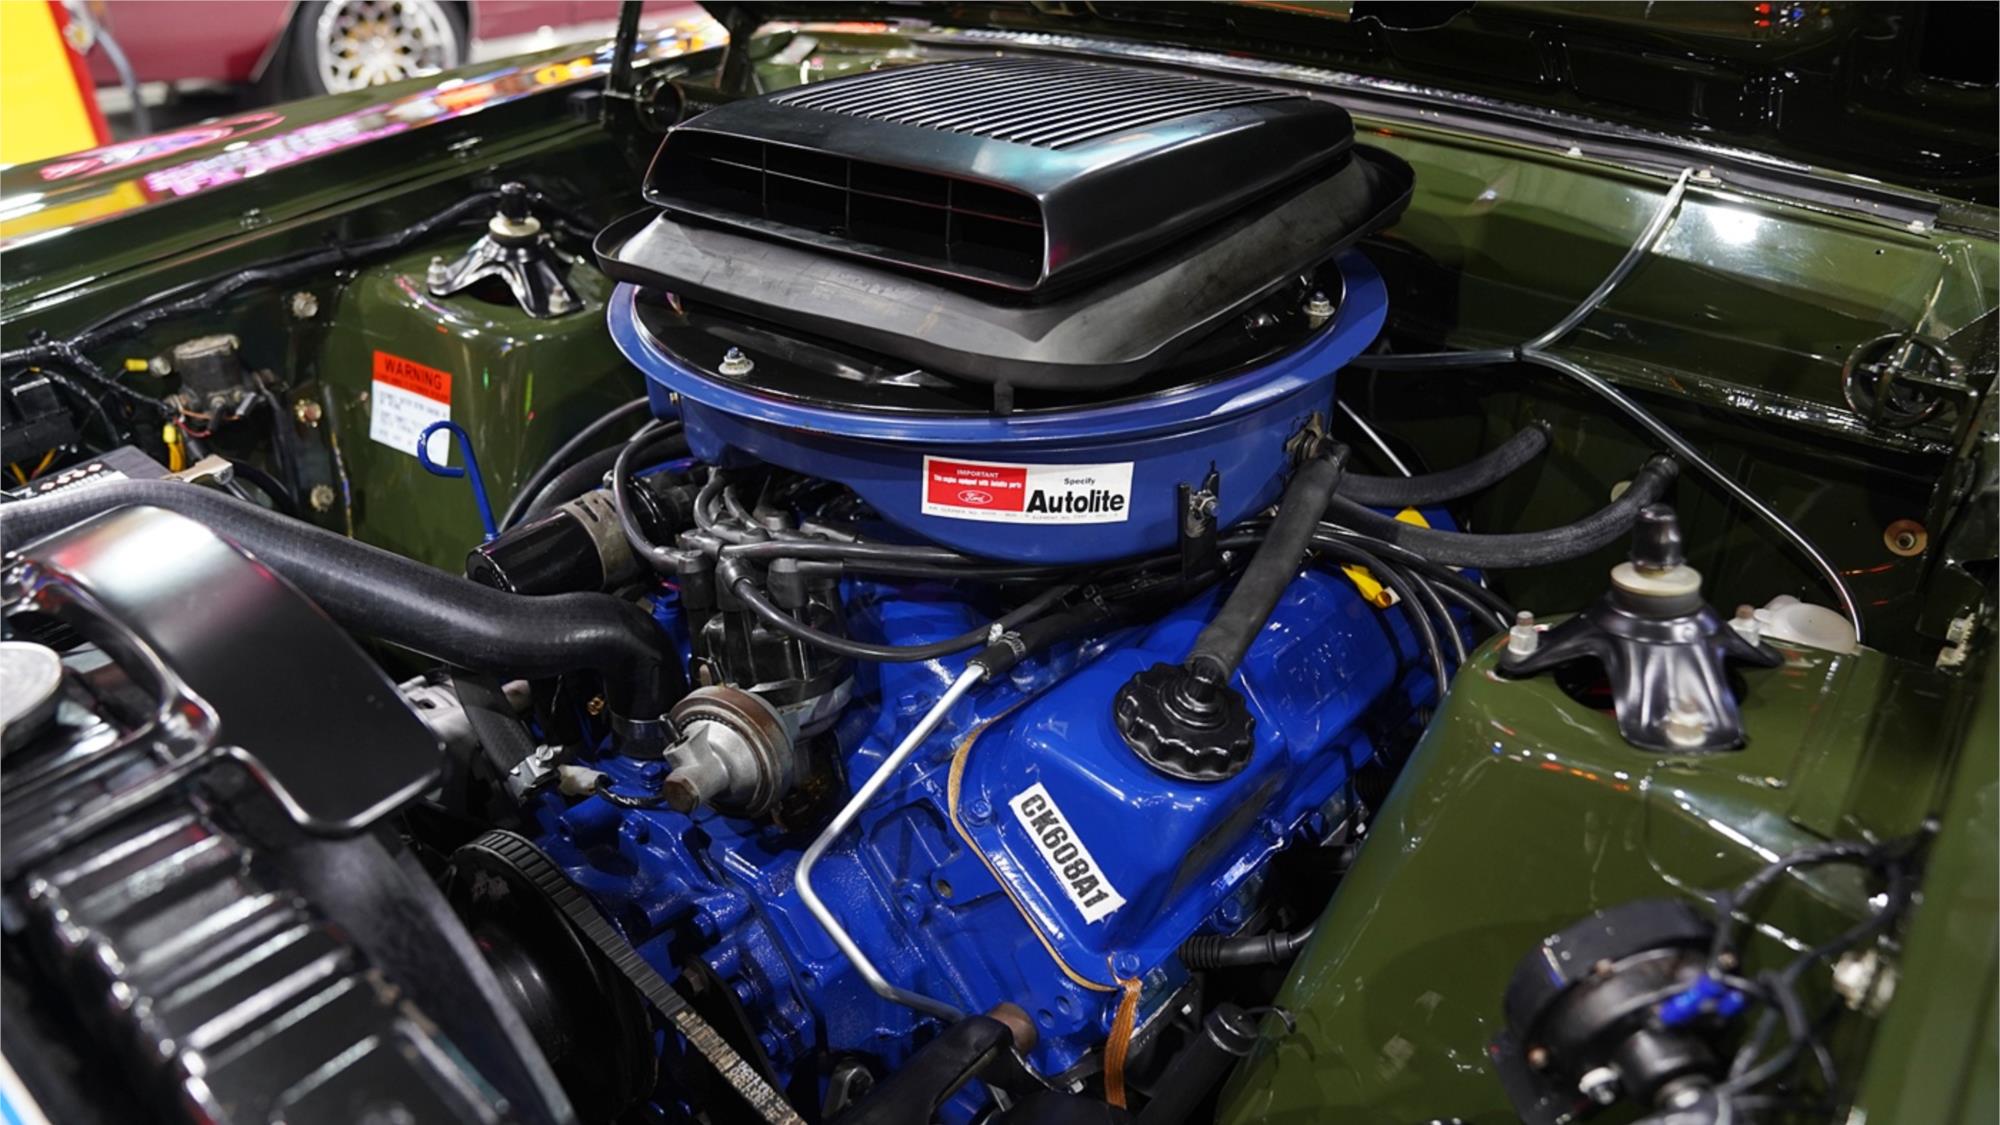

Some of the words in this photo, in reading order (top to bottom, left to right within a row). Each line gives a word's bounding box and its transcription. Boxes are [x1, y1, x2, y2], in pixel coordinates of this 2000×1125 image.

[384, 357, 442, 390] WARNING
[956, 469, 999, 478] IMPORTANT
[1063, 477, 1096, 486] Specify
[1026, 489, 1125, 514] Autolite
[1020, 793, 1110, 908] CK608A1
